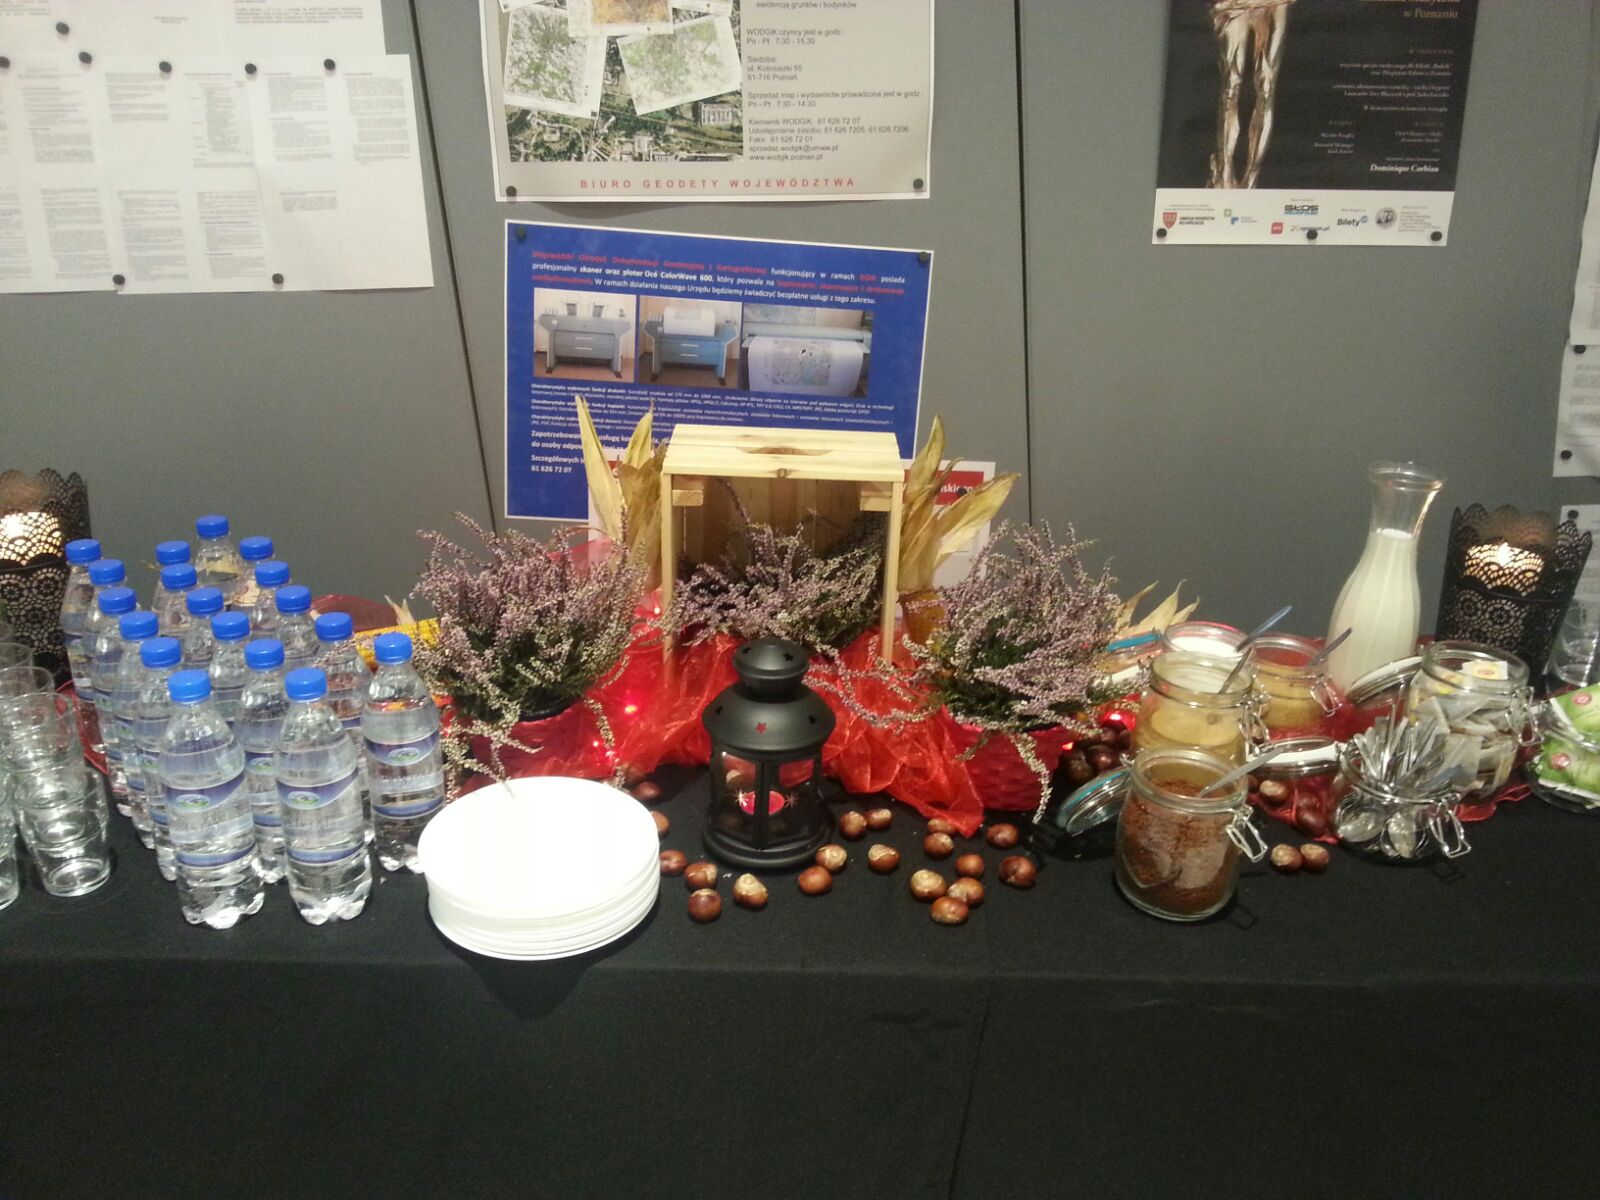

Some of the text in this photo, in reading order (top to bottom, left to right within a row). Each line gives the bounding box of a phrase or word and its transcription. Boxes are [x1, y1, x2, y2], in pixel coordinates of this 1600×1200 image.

[1414, 8, 1458, 18] Poznaniu
[580, 177, 856, 189] BIURO GEODETY WOJEWÓDZTWA
[1337, 218, 1361, 227] Bilety
[532, 262, 577, 273] profesjonalny
[580, 267, 603, 275] skaner
[622, 269, 643, 277] ploter
[644, 270, 657, 278] Océ
[661, 271, 697, 281] ColorWave
[700, 273, 714, 283] 600,
[716, 275, 734, 285] który
[736, 277, 763, 287] pozwala
[770, 267, 816, 279] funkcjonujący
[831, 273, 855, 281] ramach
[880, 276, 906, 285] posiada
[604, 279, 628, 288] ramach
[629, 280, 658, 290] działania
[659, 283, 686, 293] naszego
[686, 285, 711, 295] Urzędu
[712, 286, 742, 298] będziemy
[744, 289, 776, 299] świadczyć
[776, 291, 808, 302] bezpłatne
[809, 294, 829, 304] usługi
[834, 295, 849, 304] tego
[541, 442, 561, 451] osoby
[531, 454, 579, 465] Szczegółowych
[563, 466, 572, 474] 07
